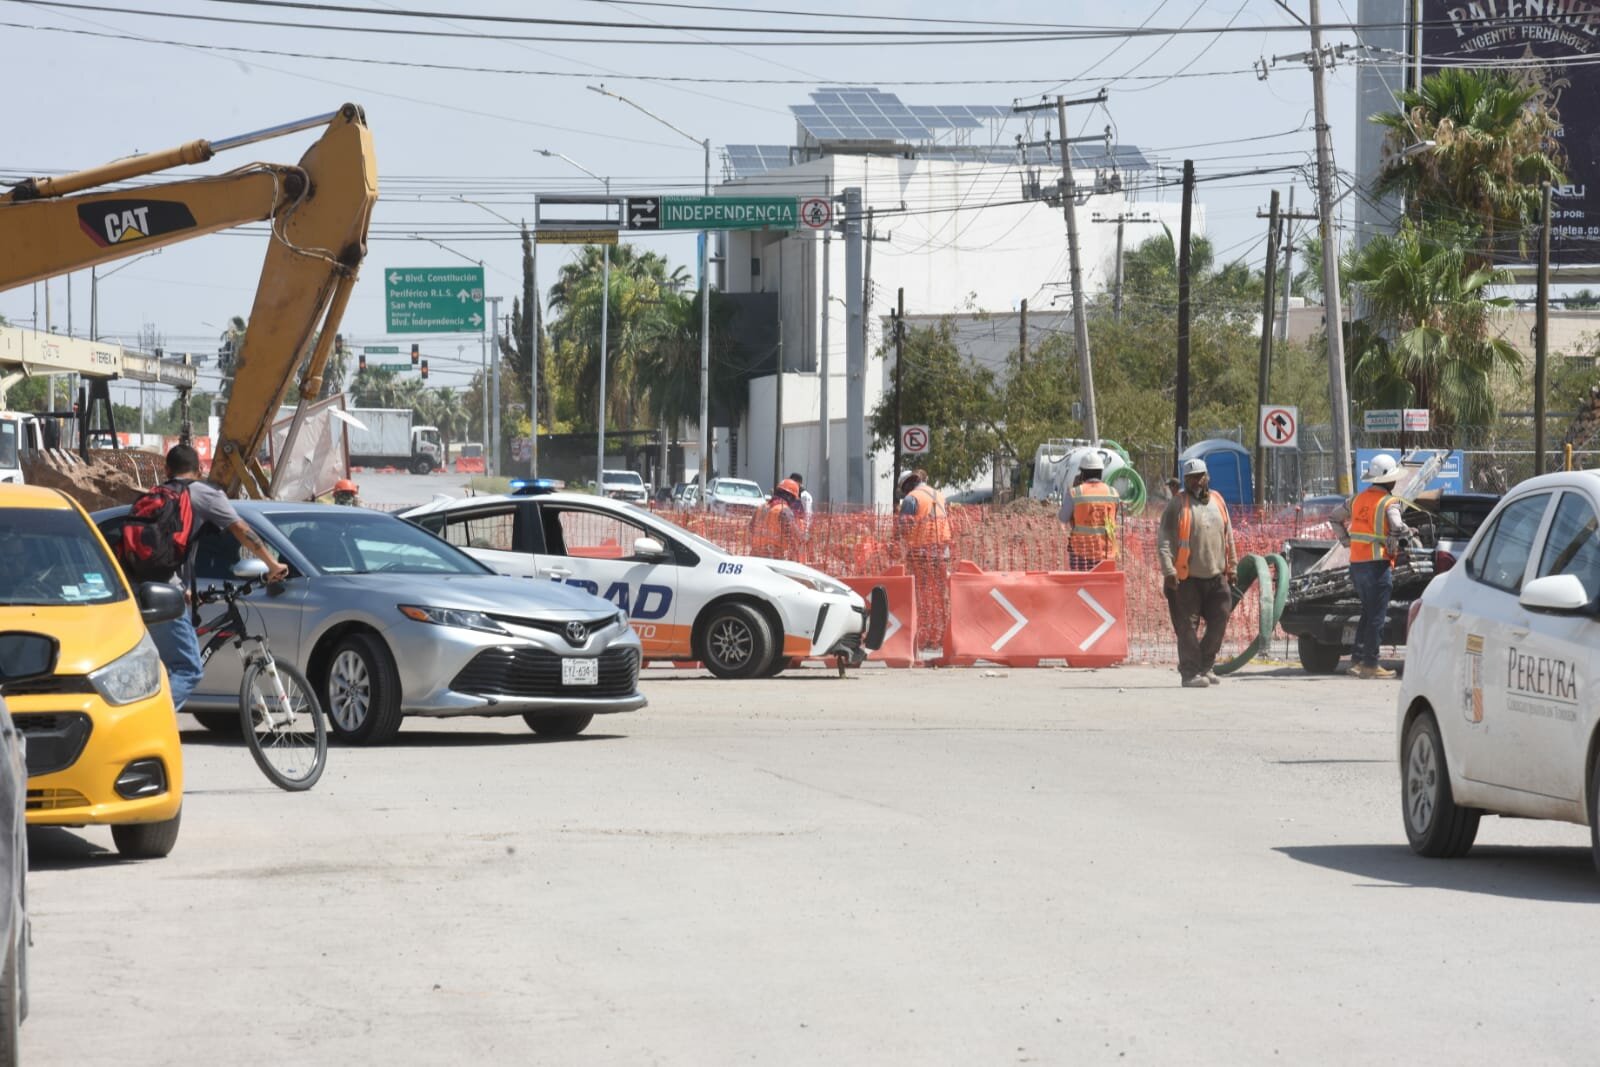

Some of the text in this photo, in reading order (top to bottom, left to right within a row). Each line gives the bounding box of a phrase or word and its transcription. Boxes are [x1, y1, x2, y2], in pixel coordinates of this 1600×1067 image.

[667, 204, 793, 222] INDEPENDENCIA
[1563, 210, 1585, 219] POR:
[104, 205, 149, 244] CAT
[405, 272, 477, 282] Blvd. Constitución
[390, 288, 454, 298] Periférico R.L.S.
[391, 301, 432, 309] San Pedro
[392, 316, 464, 327] Blvd. Independencia
[96, 351, 112, 365] TEREX
[717, 562, 744, 575] 038
[1507, 646, 1578, 700] PEREYRA
